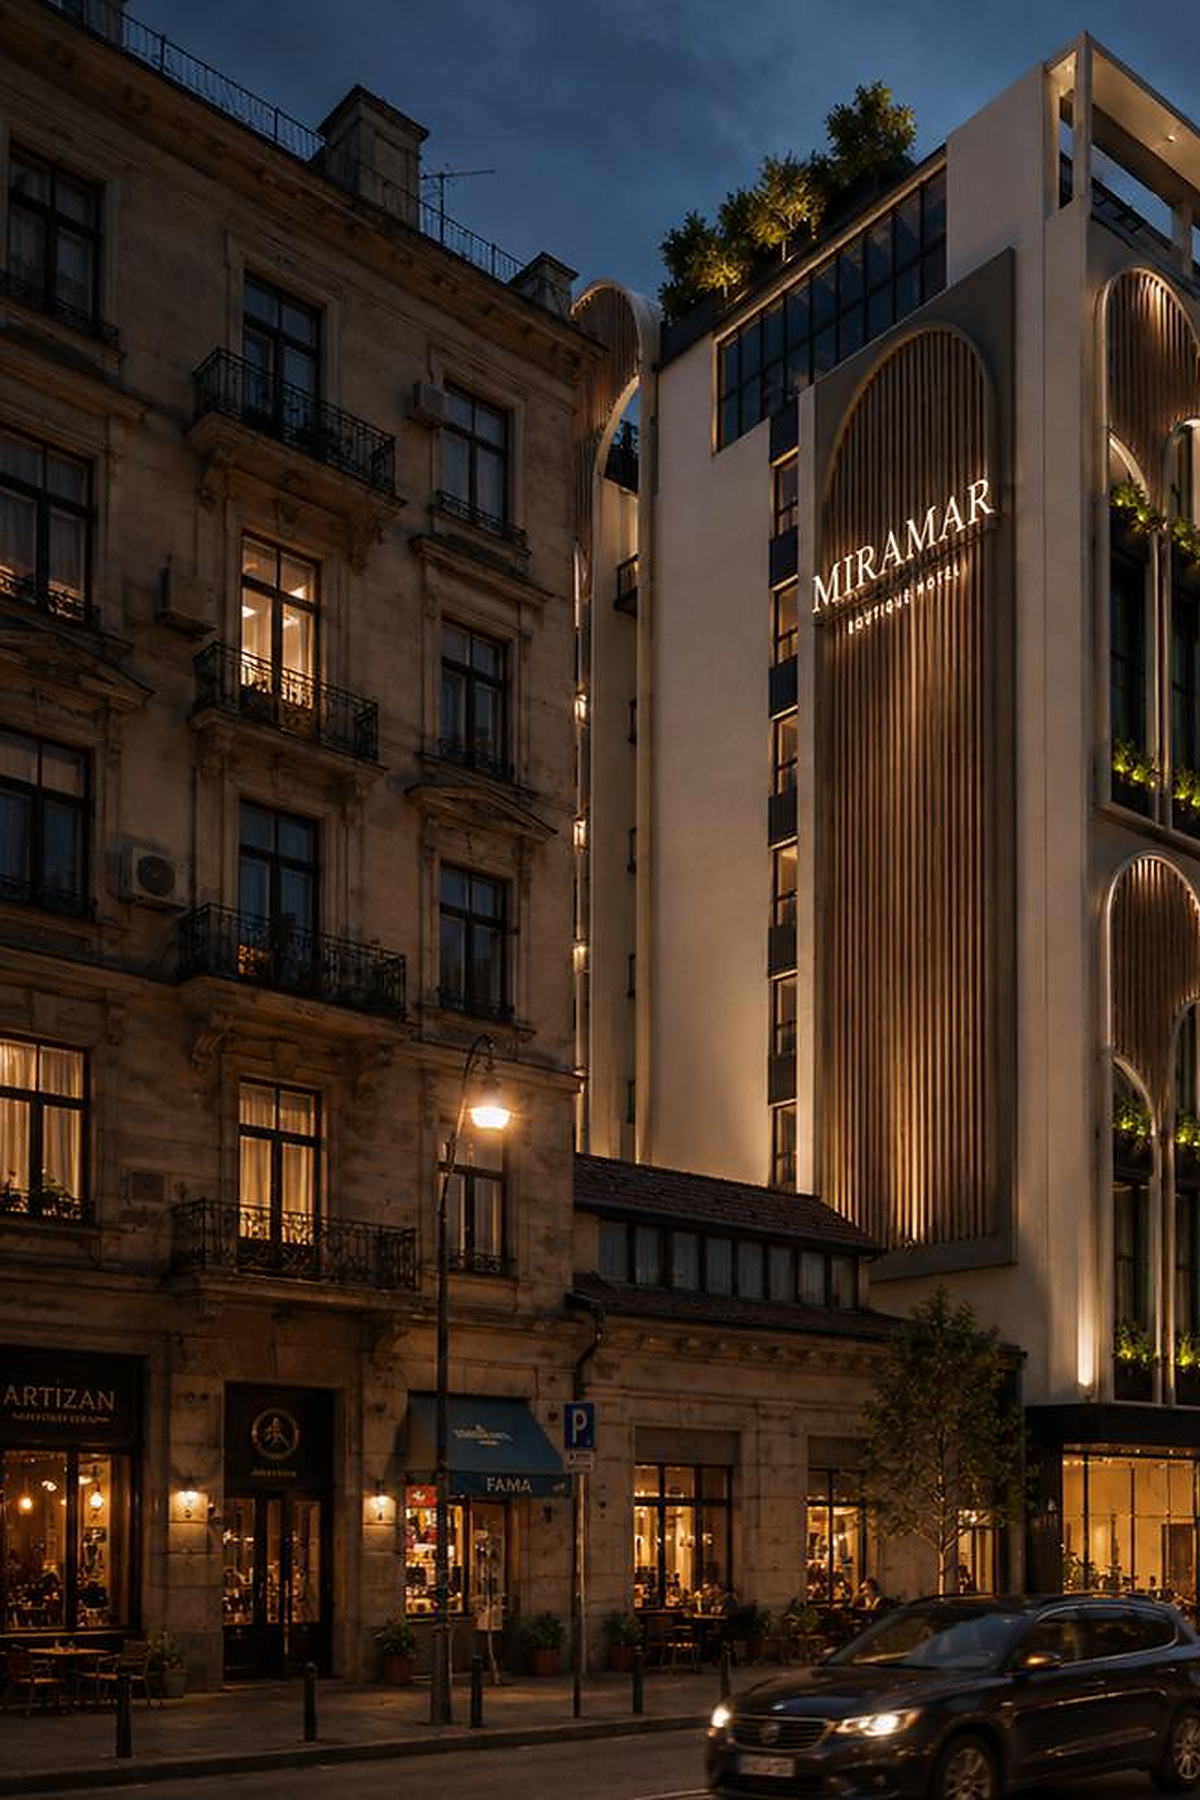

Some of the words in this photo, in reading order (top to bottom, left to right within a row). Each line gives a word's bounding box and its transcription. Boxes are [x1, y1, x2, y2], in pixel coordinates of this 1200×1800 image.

[812, 479, 995, 613] MIRAMAR
[3, 1385, 115, 1411] ARTIZAN
[572, 1408, 588, 1443] P
[486, 1476, 532, 1493] FAMA
